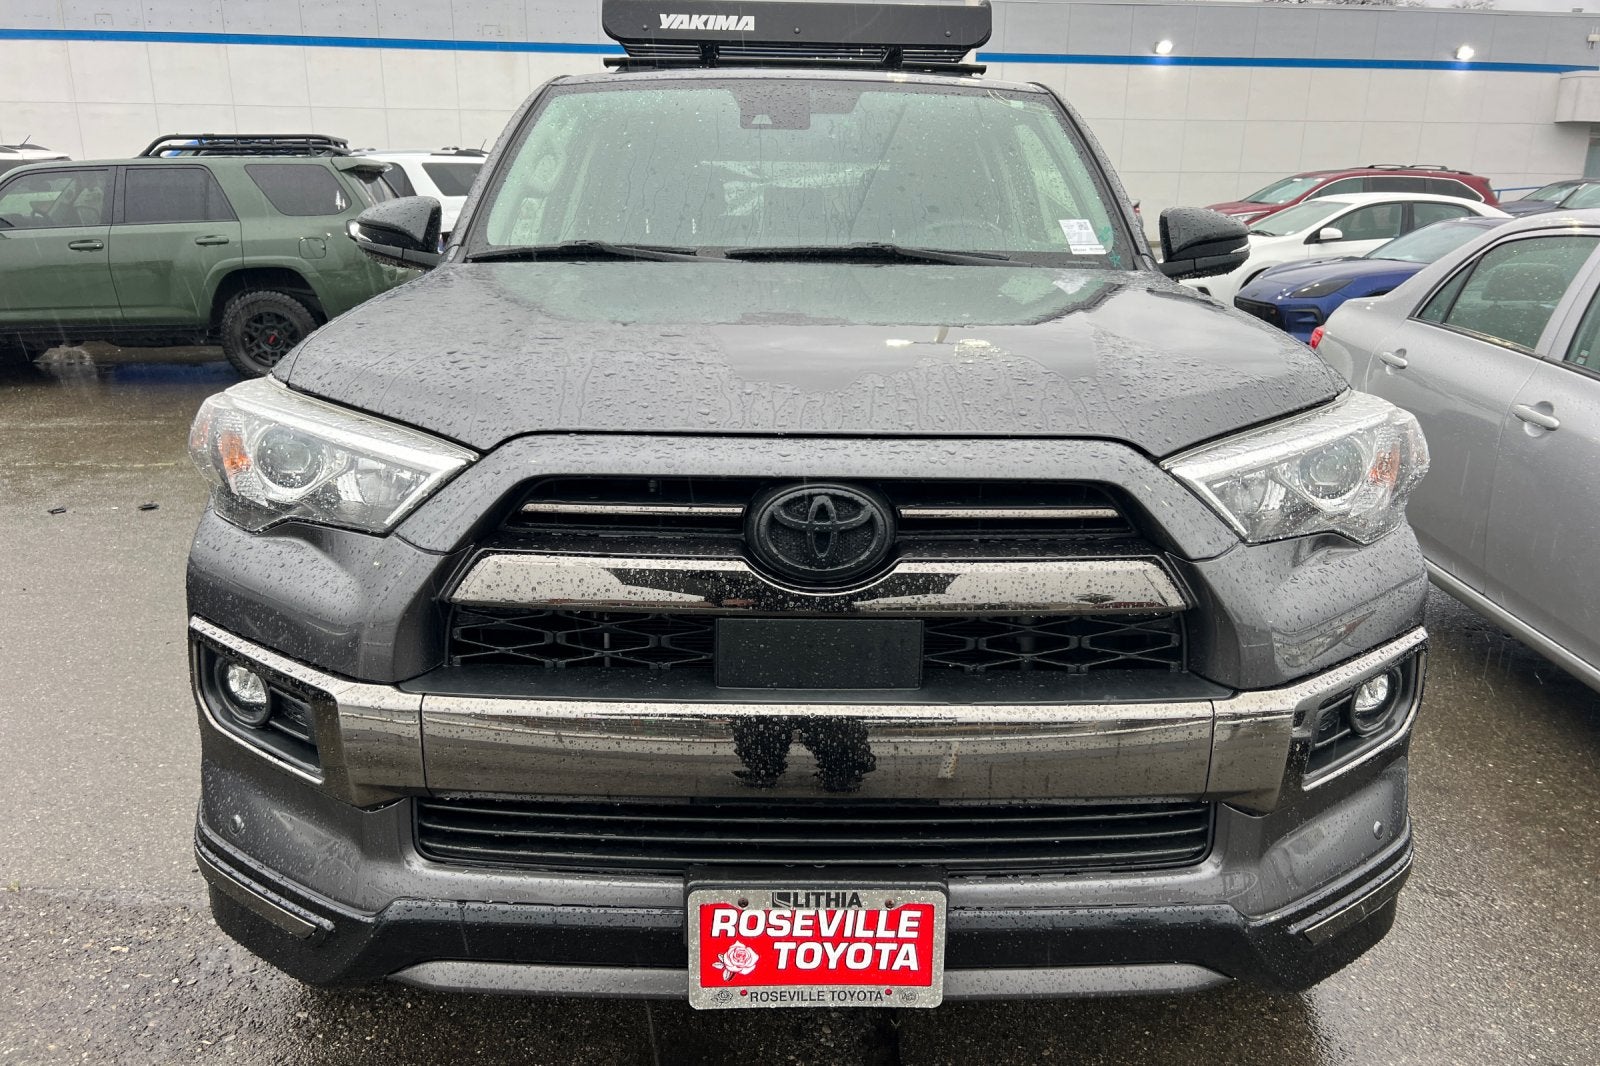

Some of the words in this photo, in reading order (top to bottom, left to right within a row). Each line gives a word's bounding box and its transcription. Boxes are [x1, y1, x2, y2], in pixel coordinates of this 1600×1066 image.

[659, 13, 756, 31] YAKIMA
[793, 891, 863, 908] LITHIA
[711, 908, 922, 938] ROSEVILLE
[773, 941, 920, 971] TOYOTA
[749, 990, 826, 1002] ROSEVILLE
[829, 990, 884, 1002] TOYOTA
